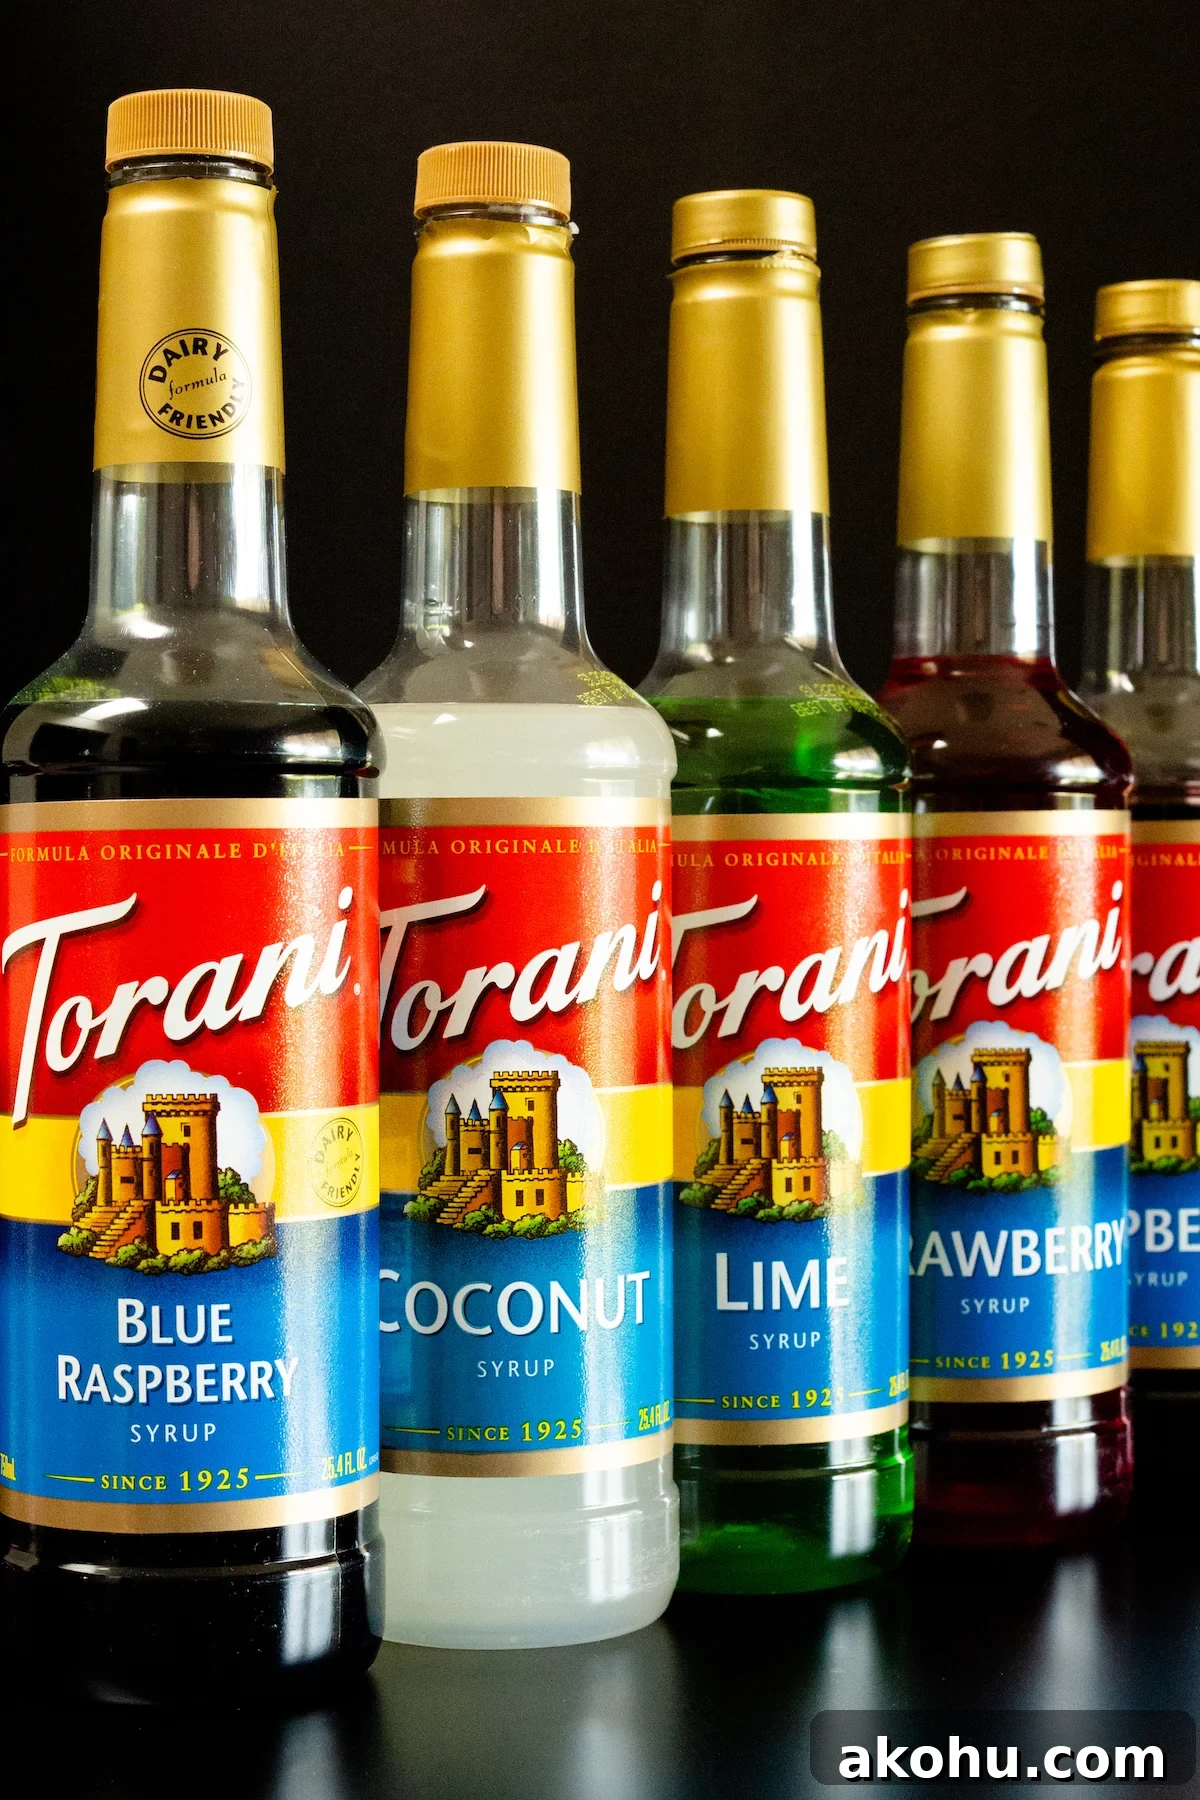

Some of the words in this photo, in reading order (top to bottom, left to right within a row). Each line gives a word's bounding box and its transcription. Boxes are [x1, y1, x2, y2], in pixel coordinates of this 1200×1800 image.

[147, 337, 230, 384] DAIRY
[168, 367, 228, 401] formula
[157, 377, 246, 429] FRIENDLY
[10, 846, 91, 863] FORMULA
[100, 843, 243, 860] ORIGINALE
[252, 842, 345, 859] D'ITLIA
[451, 838, 581, 855] ORIGINALE
[935, 846, 1049, 861] ORIGINALE
[2, 885, 355, 1126] Torani
[314, 1125, 354, 1165] DAIRY
[320, 1153, 361, 1200] FRIENDLY
[715, 1252, 851, 1311] LIME
[379, 1268, 651, 1336] COCONUT
[960, 1297, 1030, 1315] SYRUP
[117, 1297, 235, 1345] BLUE
[749, 1331, 822, 1351] SYRUP
[477, 1358, 555, 1378] SYRUP
[935, 1355, 991, 1369] SINCE
[1000, 1350, 1054, 1370] 1925
[57, 1353, 299, 1405] RASPBERRY
[721, 1395, 781, 1410] SINCE
[790, 1387, 844, 1409] 1925
[130, 1422, 217, 1444] SYRUP
[447, 1425, 510, 1442] SINCE
[521, 1418, 582, 1442] 1925
[101, 1472, 168, 1491] SINCE
[179, 1467, 250, 1493] 1925
